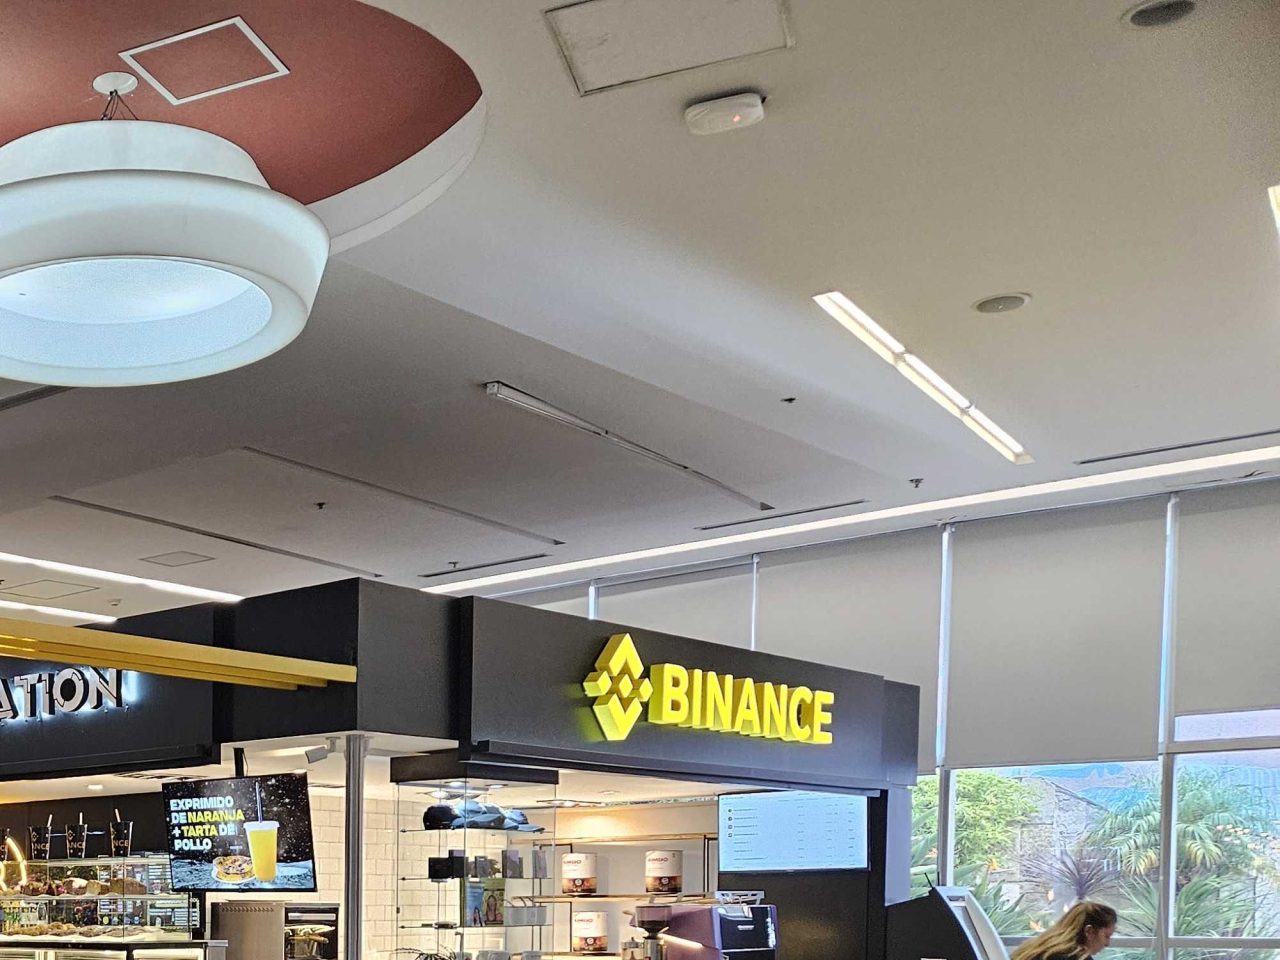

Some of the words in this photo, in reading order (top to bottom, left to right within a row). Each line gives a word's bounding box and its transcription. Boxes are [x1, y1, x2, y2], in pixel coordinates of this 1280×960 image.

[650, 663, 835, 744] BINANCE
[169, 795, 234, 810] EXPRIMIDO
[171, 812, 187, 824] DE
[187, 809, 245, 823] NARANJA
[181, 824, 218, 837] TARTA
[218, 823, 235, 836] DE
[174, 838, 212, 851] POLLO
